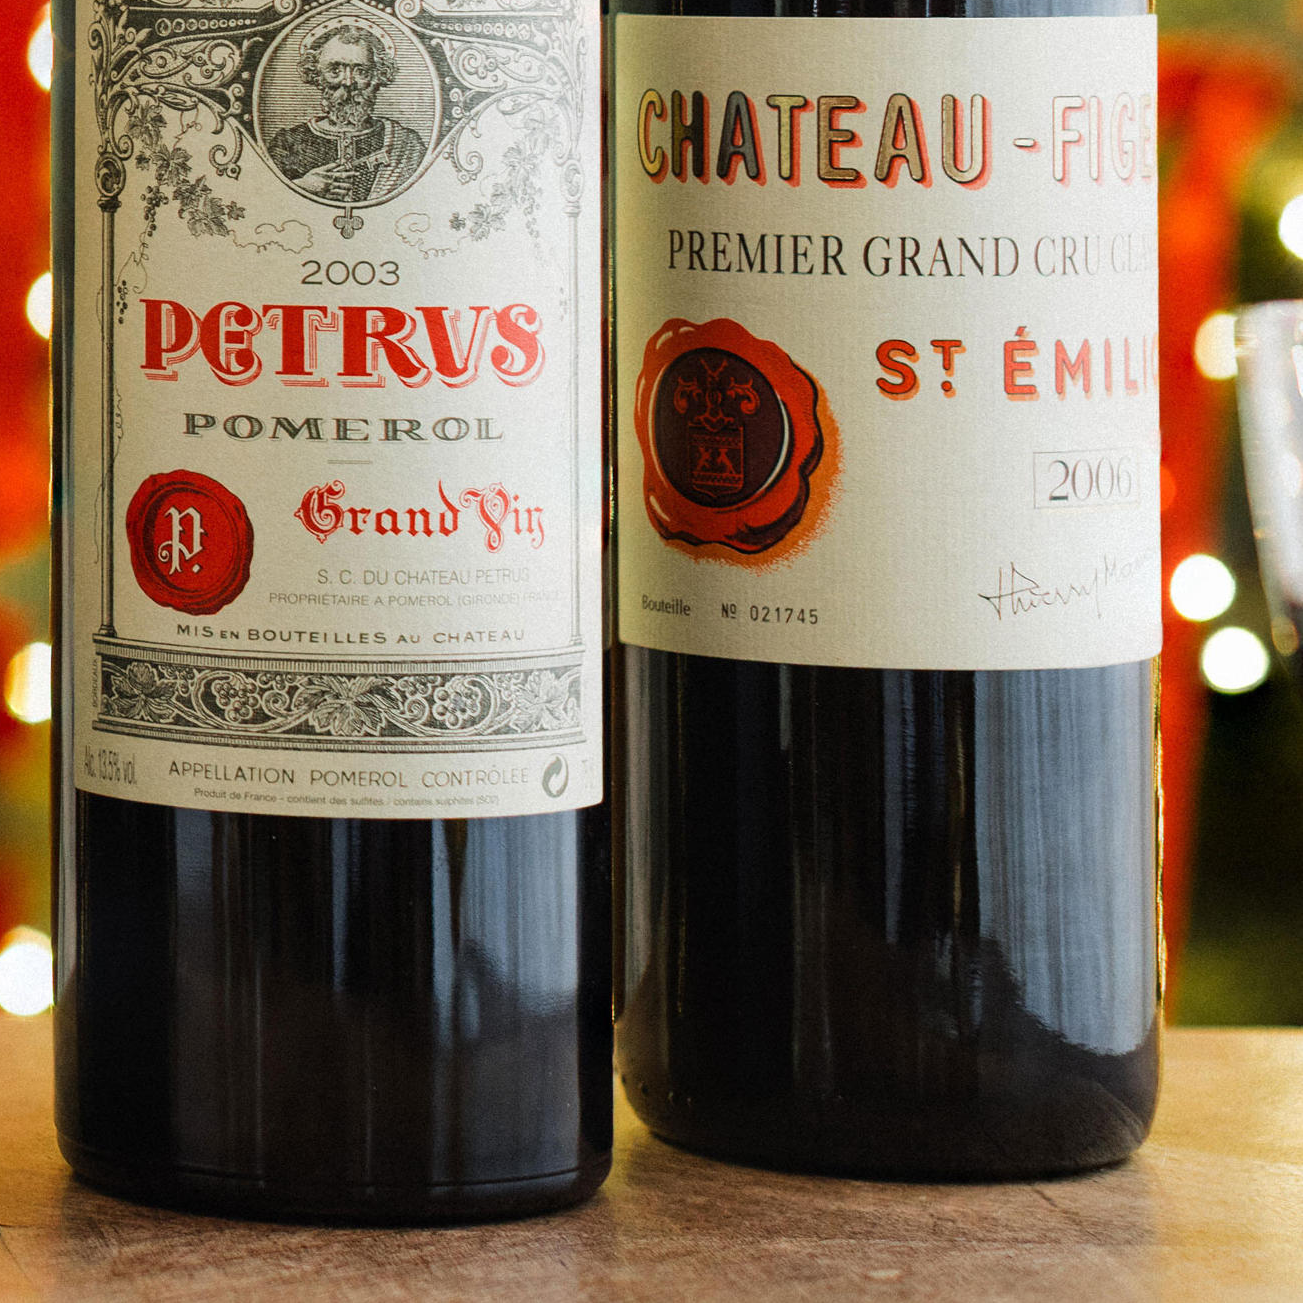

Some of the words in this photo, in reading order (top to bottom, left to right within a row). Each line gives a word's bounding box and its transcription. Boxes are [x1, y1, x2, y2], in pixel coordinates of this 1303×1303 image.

[637, 88, 990, 190] CHATEAU
[668, 228, 847, 277] PREMIER
[863, 235, 1021, 279] GRAND
[1034, 235, 1101, 278] CRU
[301, 260, 400, 286] 2003
[140, 297, 547, 388] PETRVS
[183, 412, 504, 442] POMEROL
[1048, 455, 1134, 501] 2006
[295, 478, 460, 543] Grand
[458, 480, 545, 554] Vin
[317, 569, 333, 585] S.
[339, 569, 356, 585] C.
[363, 569, 389, 585] DU
[394, 569, 469, 586] CHATEAU
[389, 594, 454, 606] POMEROL
[642, 595, 691, 617] Bouteille
[750, 605, 818, 625] 021745
[177, 624, 214, 637] MIS
[220, 630, 239, 640] EN
[248, 628, 387, 644] BOUTEILLES
[397, 633, 421, 644] AU
[433, 629, 525, 644] CHATEAU
[169, 761, 294, 784] APPELLATION
[310, 769, 408, 788] POMEROL
[194, 787, 226, 800] Produit
[229, 789, 242, 801] de
[244, 791, 277, 803] France
